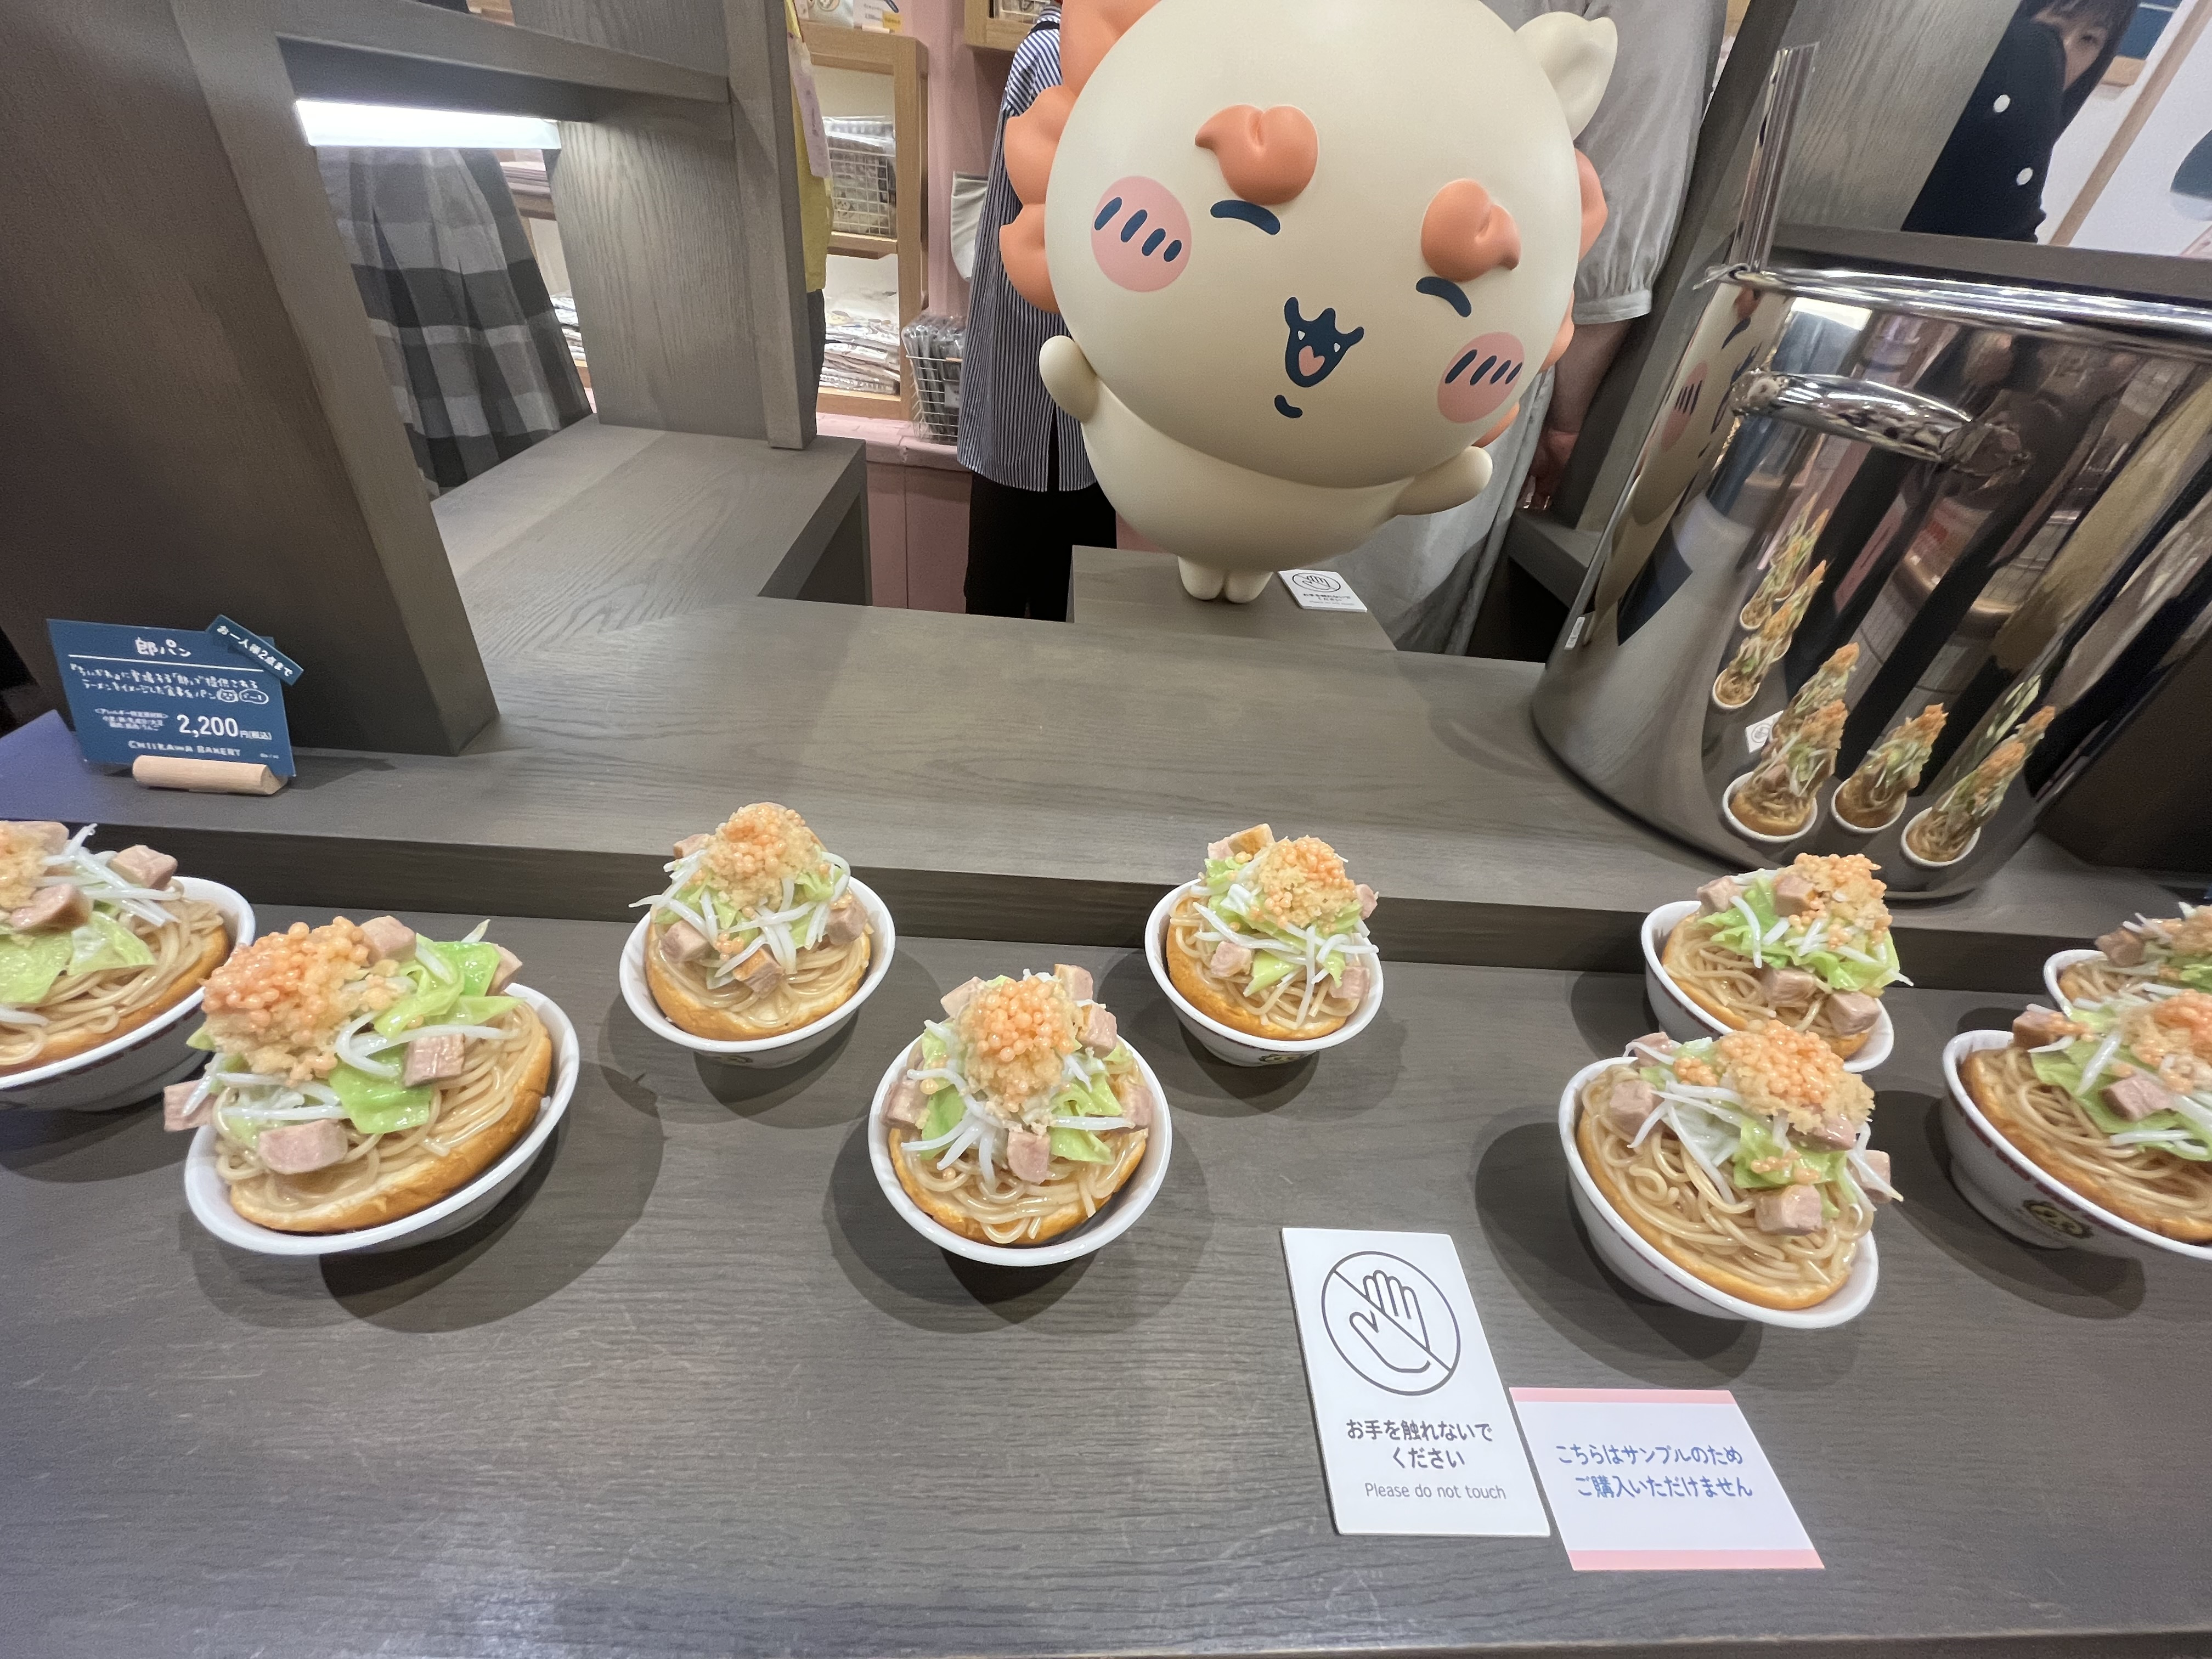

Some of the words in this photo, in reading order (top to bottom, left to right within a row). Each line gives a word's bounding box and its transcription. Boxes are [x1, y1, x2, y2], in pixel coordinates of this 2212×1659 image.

[134, 636, 191, 657] 郎パン
[196, 745, 241, 757] BAKERY
[1346, 1419, 1493, 1442] お手を触れないで
[1392, 1447, 1465, 1469] ください
[1555, 1444, 1743, 1465] こちらはサンプルのため
[1365, 1482, 1410, 1498] Please
[1414, 1483, 1432, 1498] do
[1436, 1485, 1462, 1499] not
[1465, 1485, 1507, 1500] touch
[1575, 1475, 1753, 1499] ご購入いただけません
